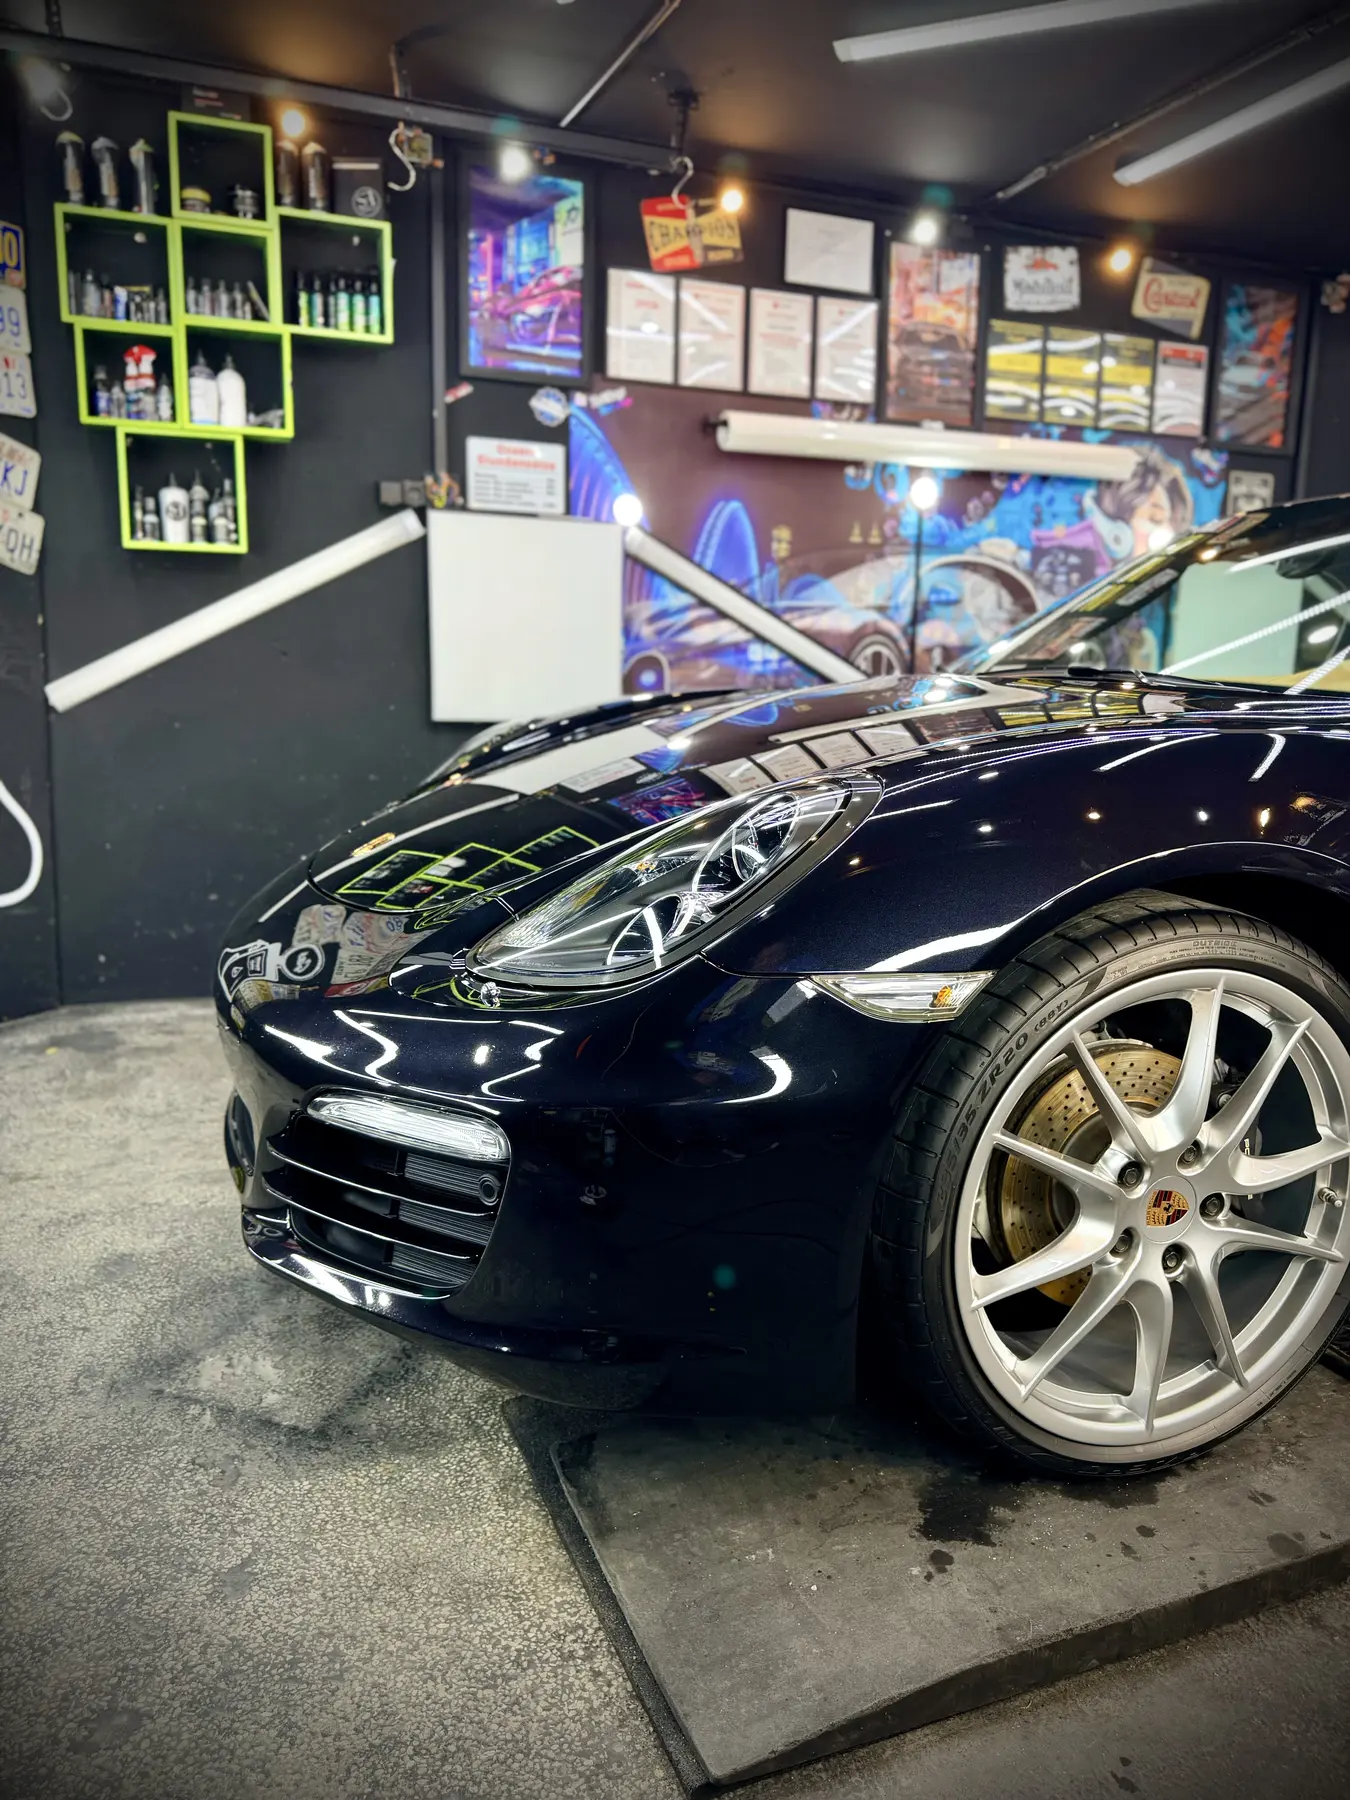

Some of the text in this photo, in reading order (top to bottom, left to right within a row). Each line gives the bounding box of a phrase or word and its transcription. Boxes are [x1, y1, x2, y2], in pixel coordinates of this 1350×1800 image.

[0, 230, 18, 268] 0
[978, 1032, 1028, 1104] ZR20
[1034, 1000, 1069, 1032] (88Y)
